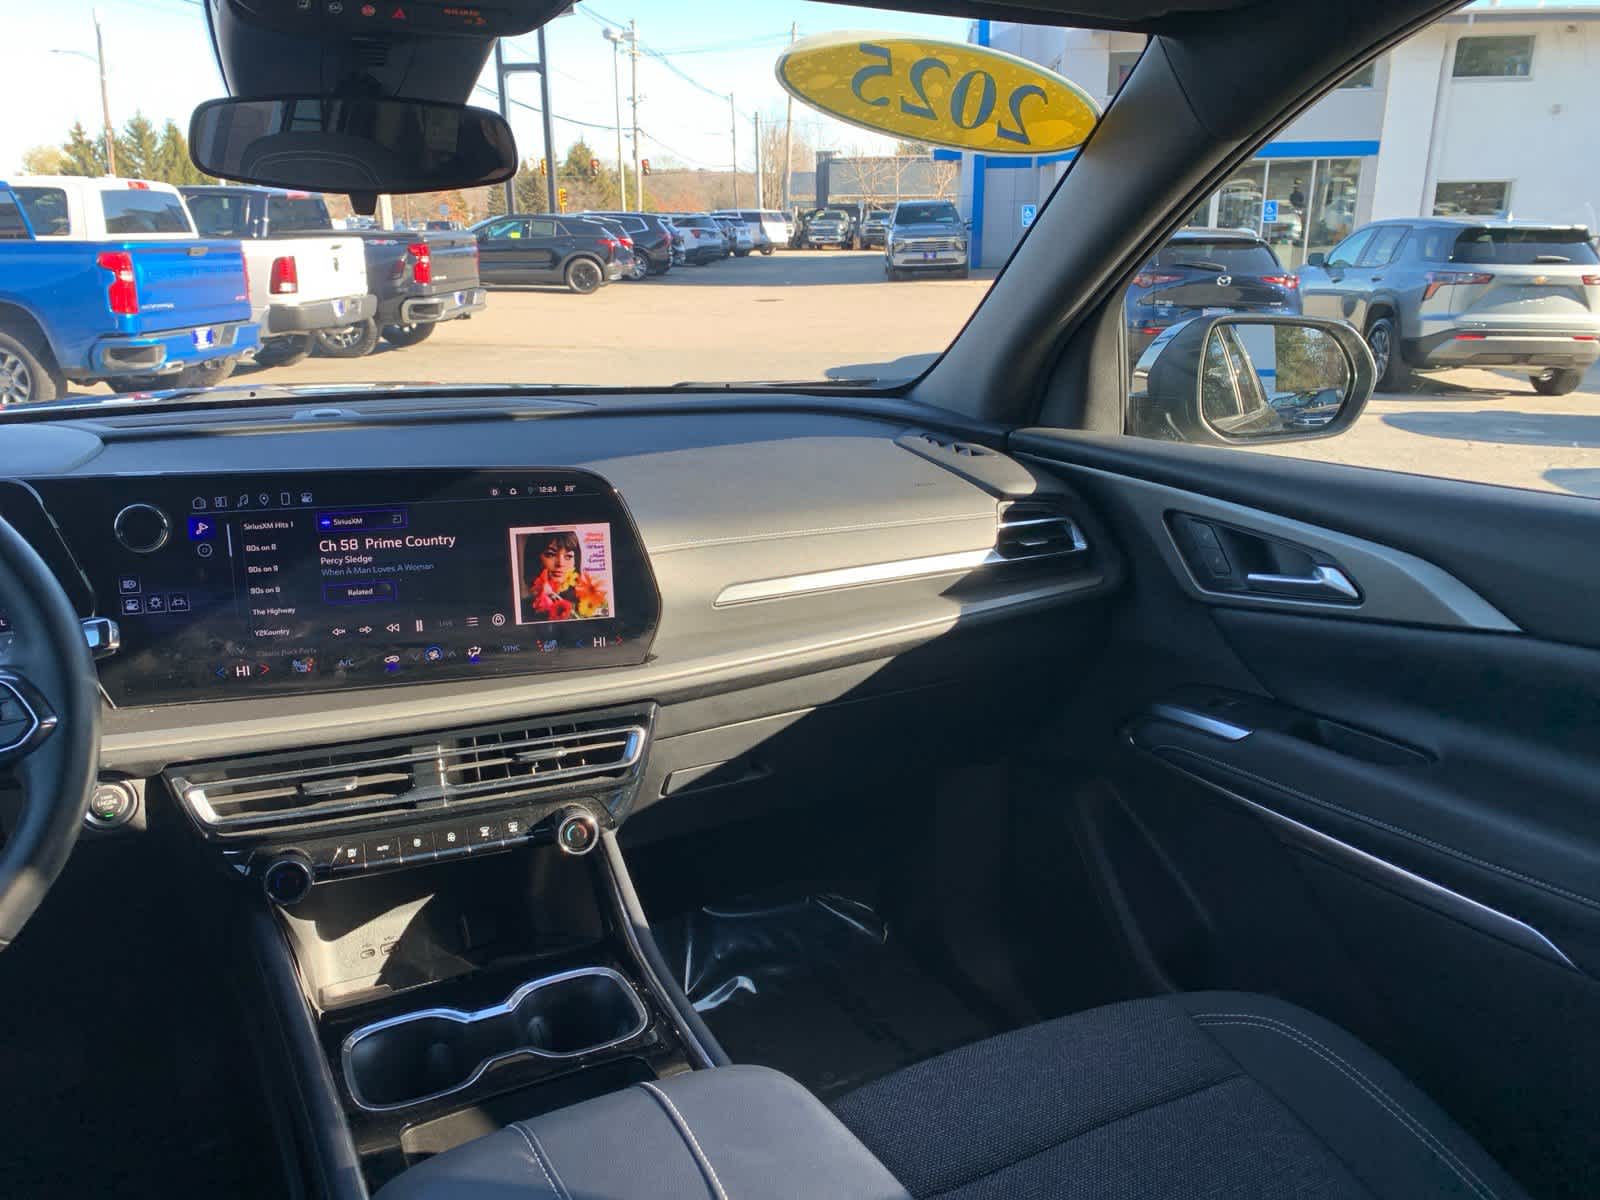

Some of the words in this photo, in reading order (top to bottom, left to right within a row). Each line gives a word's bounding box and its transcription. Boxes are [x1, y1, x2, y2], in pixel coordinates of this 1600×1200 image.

[243, 522, 274, 530] SiriusXM
[275, 521, 289, 529] Hits
[333, 518, 363, 526] SiriusXM
[319, 540, 337, 552] Ch
[340, 538, 359, 551] 58
[365, 537, 403, 550] Prime
[405, 535, 456, 548] Country
[320, 556, 343, 566] Percy
[344, 555, 373, 565] Sledge
[321, 567, 344, 576] When
[345, 567, 352, 575] A
[353, 566, 371, 574] Man
[372, 565, 397, 574] Loves
[397, 564, 404, 572] A
[404, 562, 434, 571] Woman
[347, 588, 373, 597] Related
[253, 608, 265, 616] The
[267, 607, 295, 616] Highway
[254, 628, 290, 637] Y2Kountry
[593, 636, 607, 648] HI
[236, 665, 250, 677] HI
